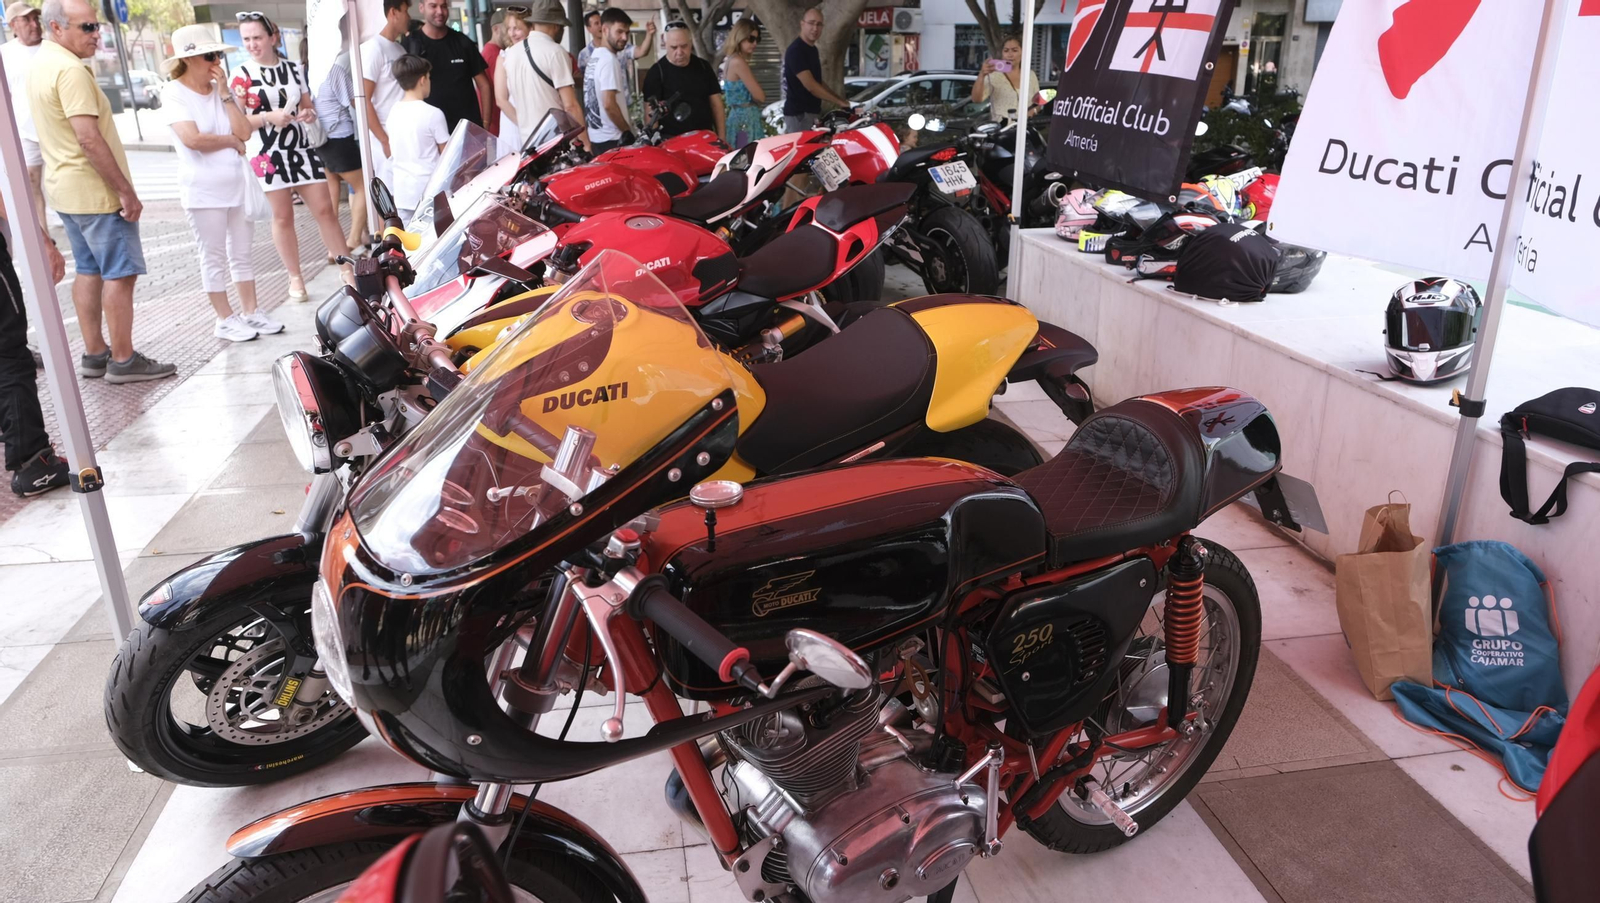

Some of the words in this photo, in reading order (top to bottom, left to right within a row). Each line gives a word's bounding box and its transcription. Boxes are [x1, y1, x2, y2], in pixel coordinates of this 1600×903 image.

[241, 61, 301, 87] LOVE
[1072, 96, 1121, 125] Official
[1122, 104, 1170, 135] Club
[1064, 130, 1098, 152] Almería
[265, 148, 328, 185] ARE
[940, 162, 967, 179] 1645
[1318, 138, 1460, 195] Ducati
[584, 177, 612, 191] DUCATI
[944, 173, 967, 188] HHK
[542, 381, 629, 414] DUCATI
[763, 600, 780, 609] MOTO
[780, 592, 812, 607] DUCATI
[1012, 623, 1054, 654] 250
[1472, 639, 1523, 651] GRUPO
[1005, 635, 1054, 673] Sport
[1470, 654, 1524, 666] CAJAMAR
[1471, 648, 1524, 658] COOPERATIVO
